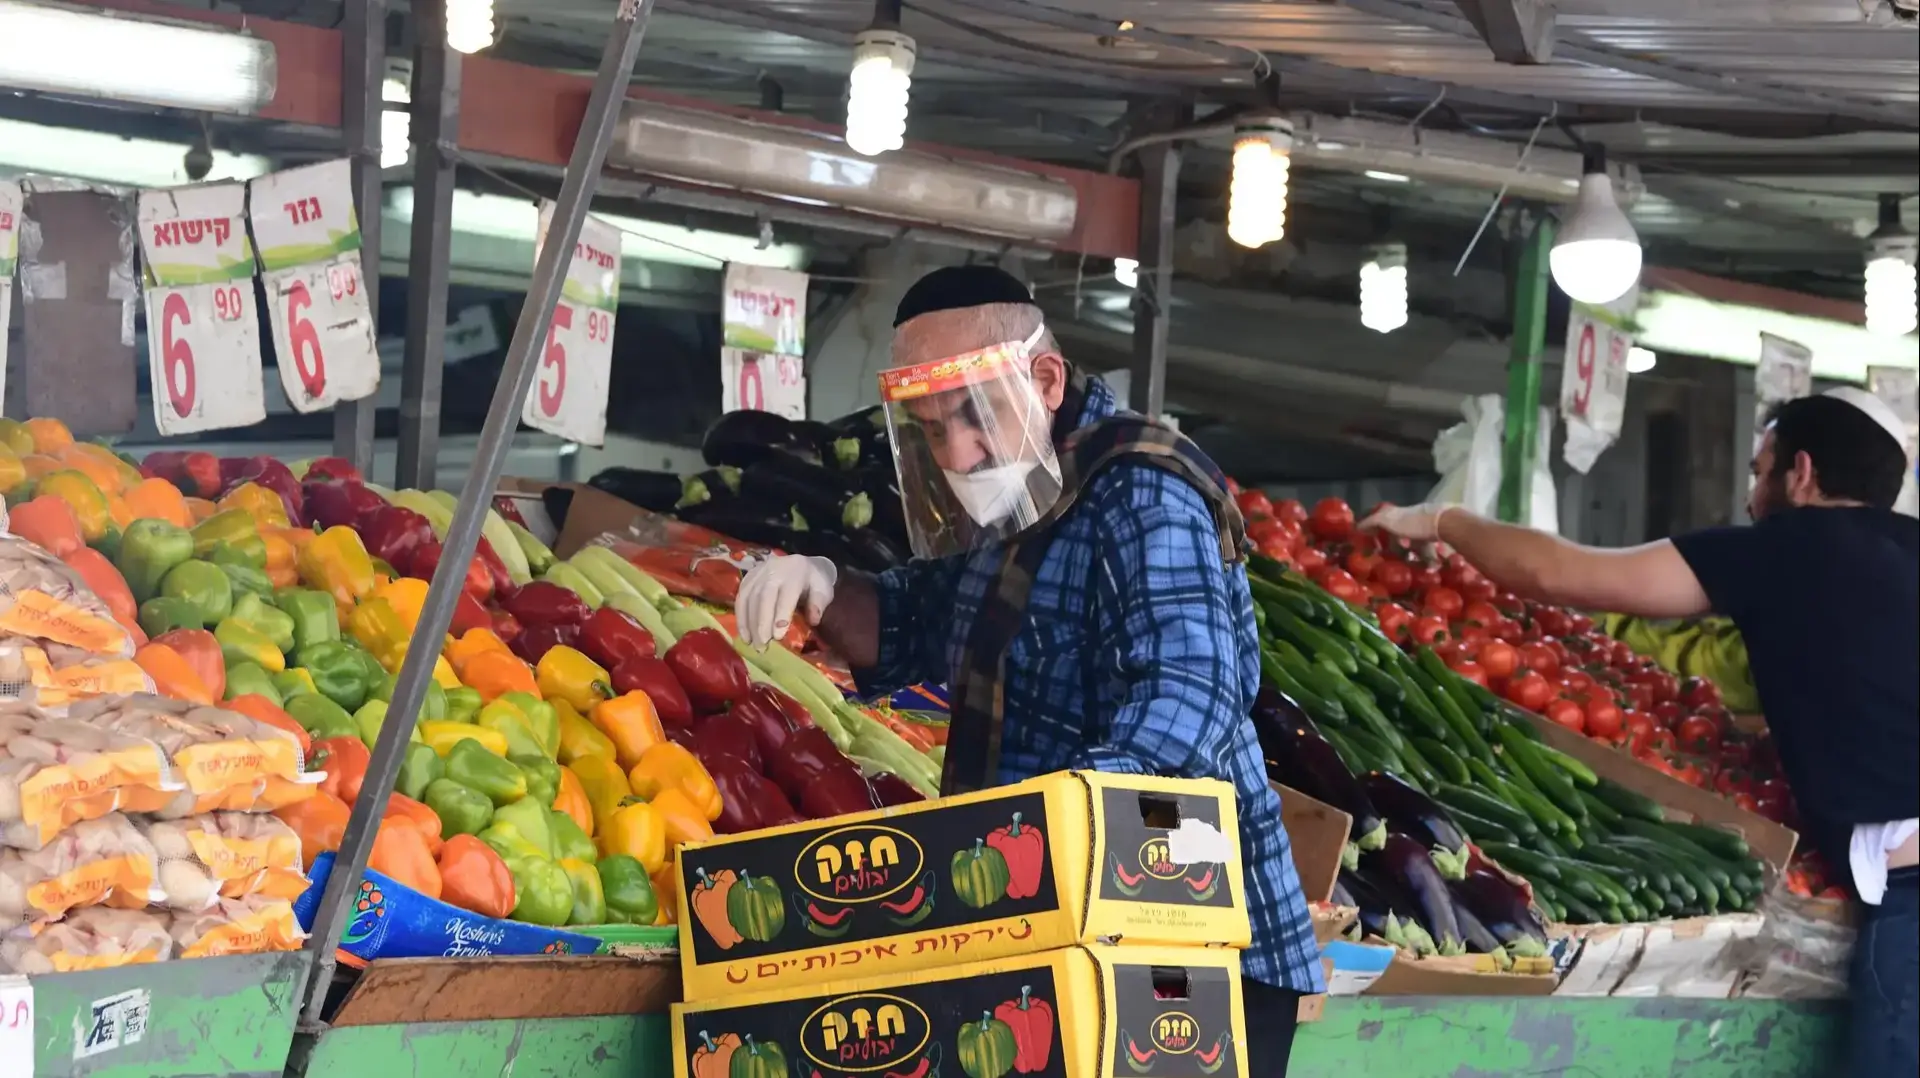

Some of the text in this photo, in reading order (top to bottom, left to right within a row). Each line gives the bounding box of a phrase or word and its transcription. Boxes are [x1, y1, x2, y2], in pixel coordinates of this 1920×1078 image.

[154, 217, 230, 247] קישוא
[284, 197, 322, 225] גזר
[586, 244, 615, 269] חציל
[162, 287, 242, 418] 6 90
[288, 279, 325, 398] 6
[540, 301, 609, 417] 5 90
[816, 835, 899, 884] חזק
[756, 926, 1004, 979] ירקות איכותיים
[822, 1004, 906, 1051] חזק
[1160, 1019, 1191, 1041] חזק
